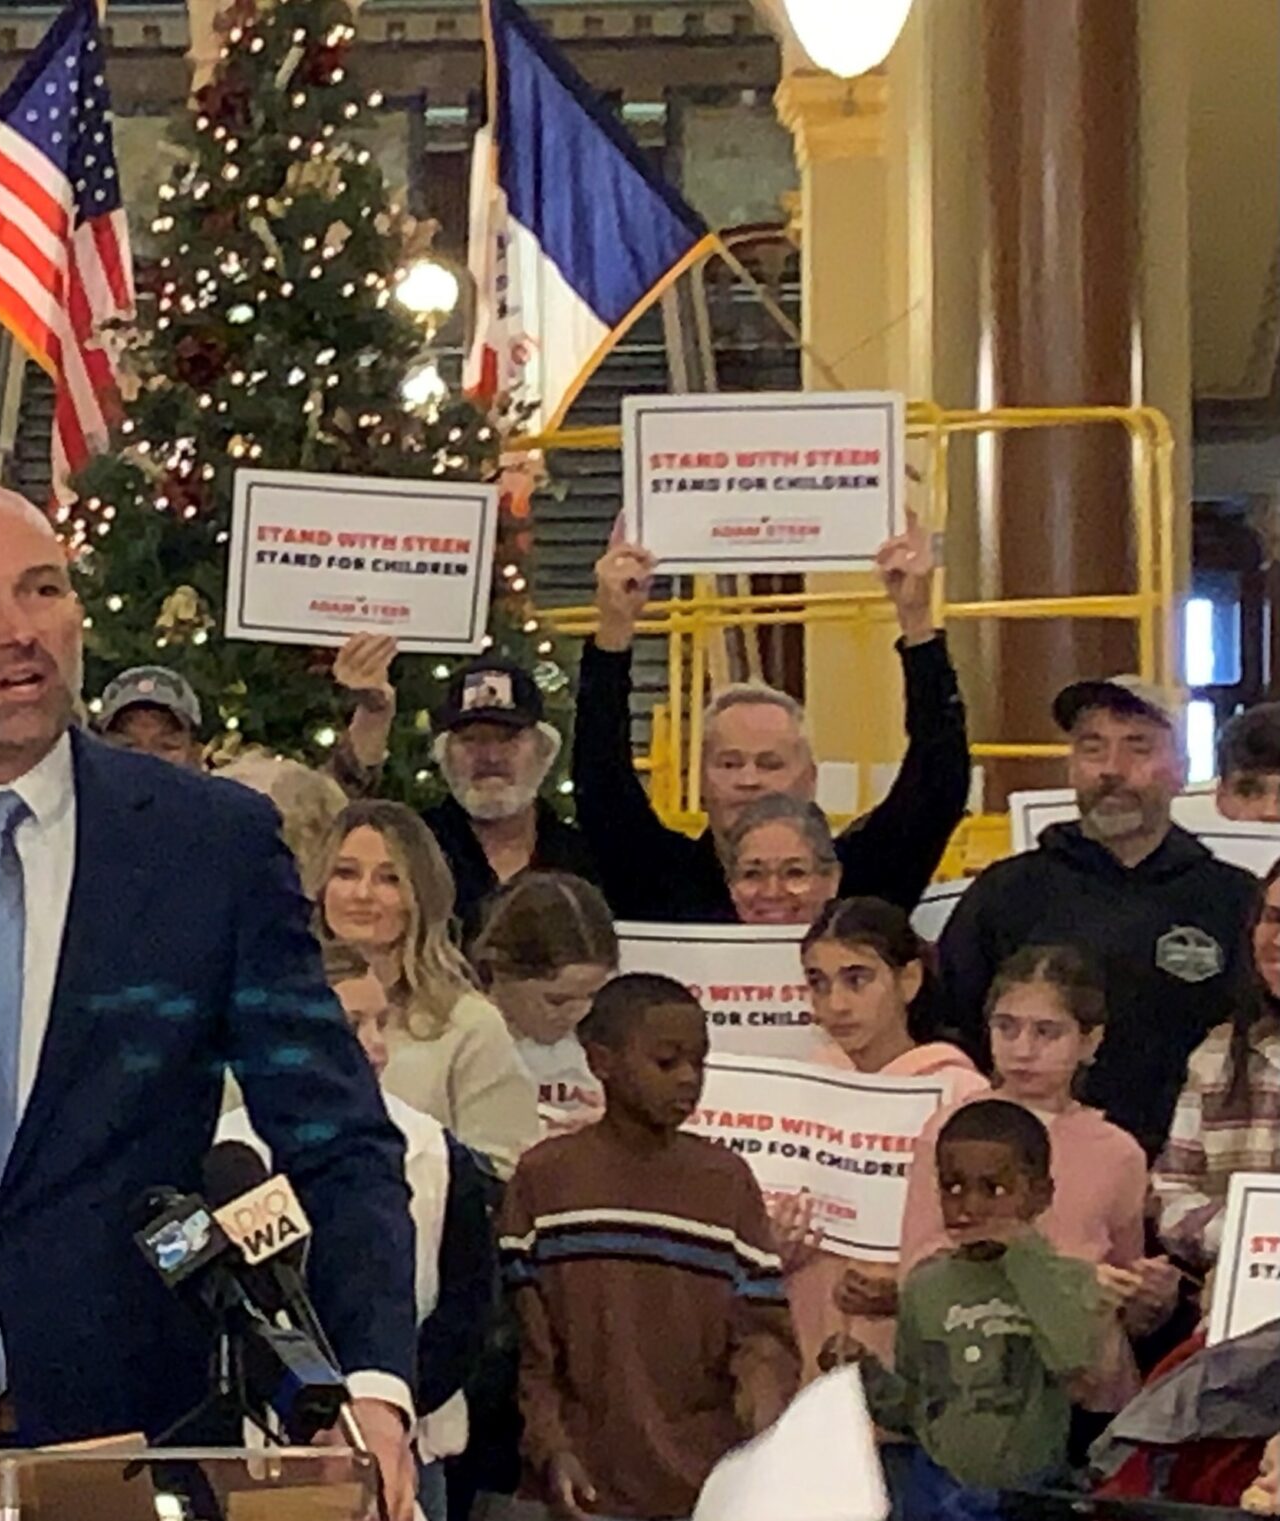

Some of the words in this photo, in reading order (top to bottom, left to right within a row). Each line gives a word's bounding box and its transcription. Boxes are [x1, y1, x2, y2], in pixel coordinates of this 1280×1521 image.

[650, 452, 729, 470] STAND
[736, 450, 798, 468] WITH
[805, 449, 880, 467] STEEN
[651, 477, 720, 493] STAND
[726, 477, 767, 492] FOR
[773, 475, 879, 491] CHILDREN
[257, 525, 333, 547] STAND
[338, 532, 398, 551] WITH
[402, 536, 471, 554] STEEN
[256, 550, 321, 569] STAND
[327, 555, 365, 571] FOR
[371, 558, 468, 576] CHILDREN
[709, 985, 774, 1002] WITH
[781, 1117, 843, 1145] WITH
[769, 1141, 811, 1162] FOR
